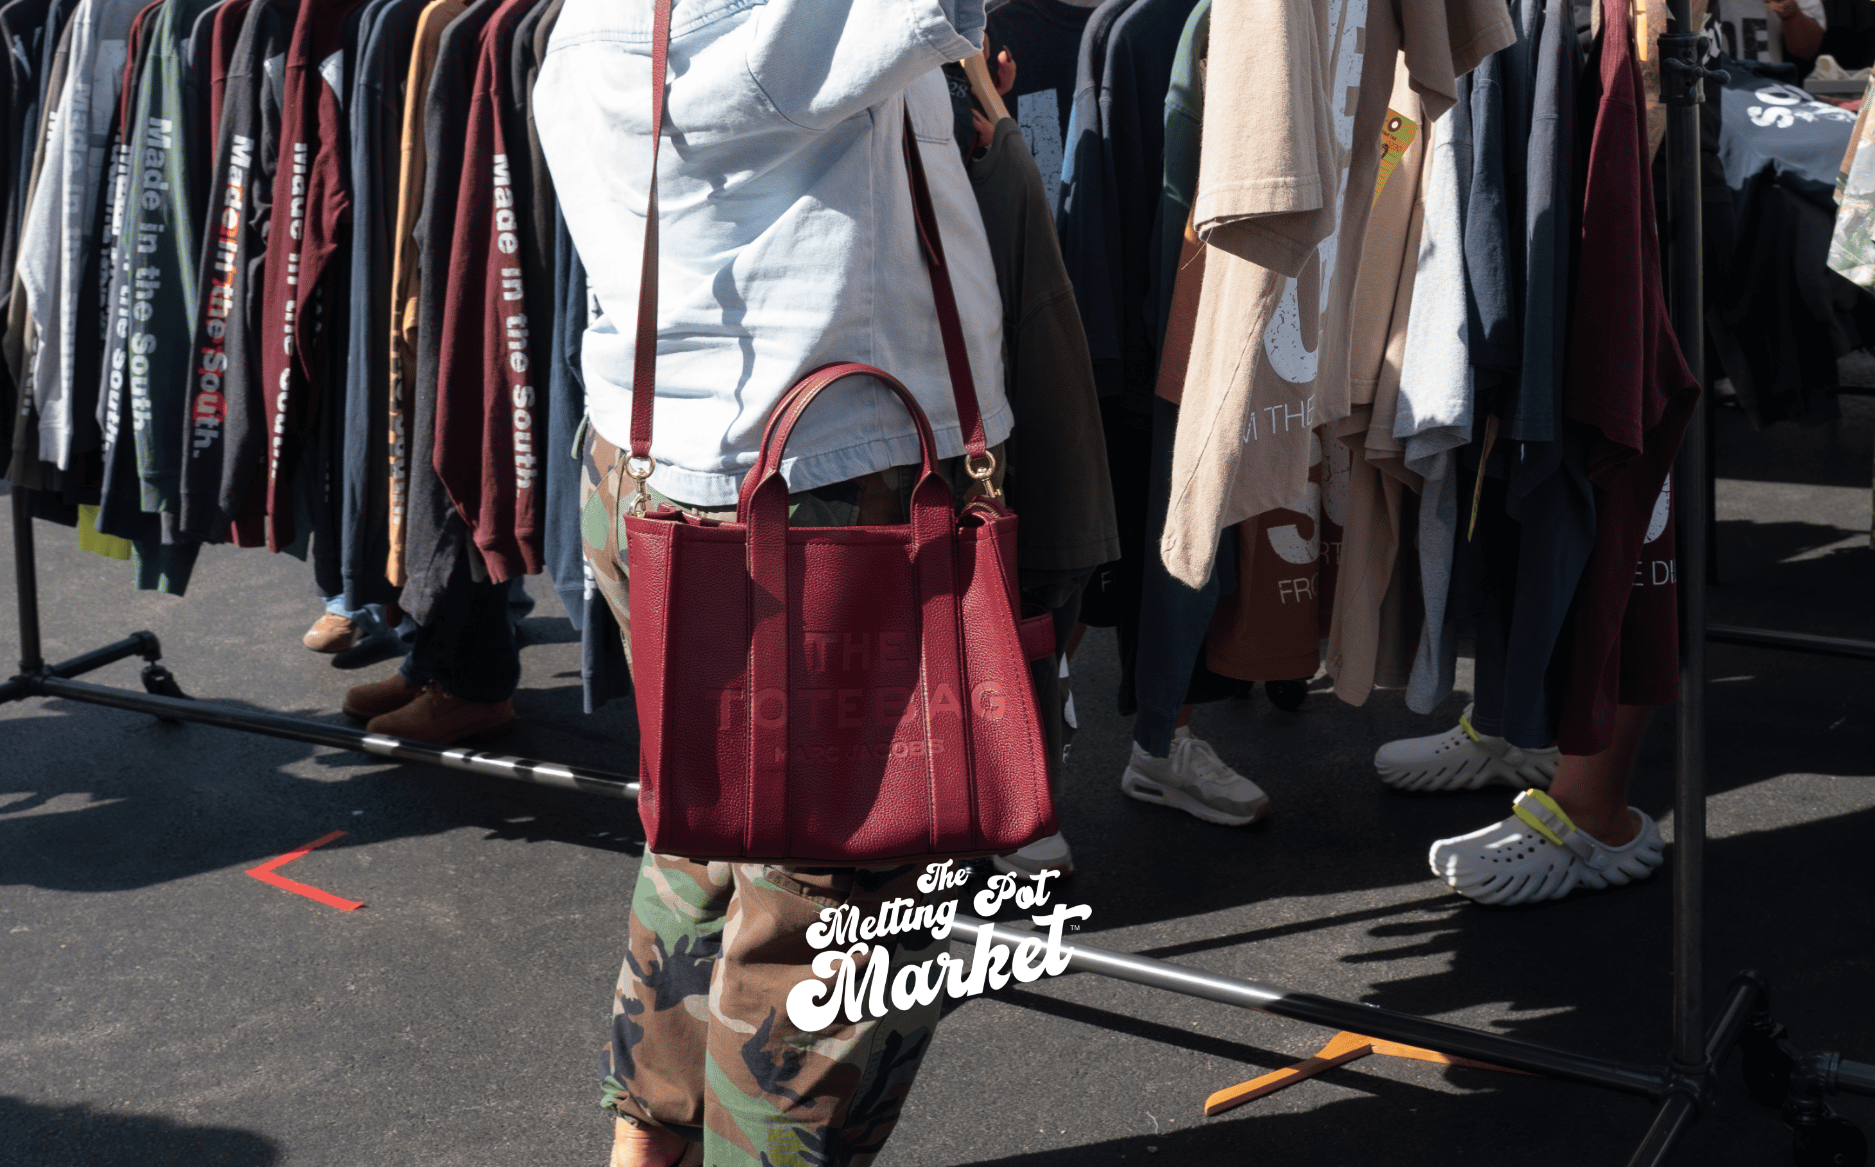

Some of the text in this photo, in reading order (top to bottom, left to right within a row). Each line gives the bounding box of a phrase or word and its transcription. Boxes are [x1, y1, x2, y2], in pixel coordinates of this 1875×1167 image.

[142, 116, 173, 211] Made
[493, 153, 519, 254] Made
[137, 222, 165, 254] in
[132, 266, 161, 322] the
[193, 134, 255, 459] Made in the South.
[500, 267, 524, 301] in
[506, 313, 529, 373] the
[803, 630, 910, 674] THE
[706, 680, 1007, 732] TOTE BAG
[774, 738, 945, 764] MARC JACOBS
